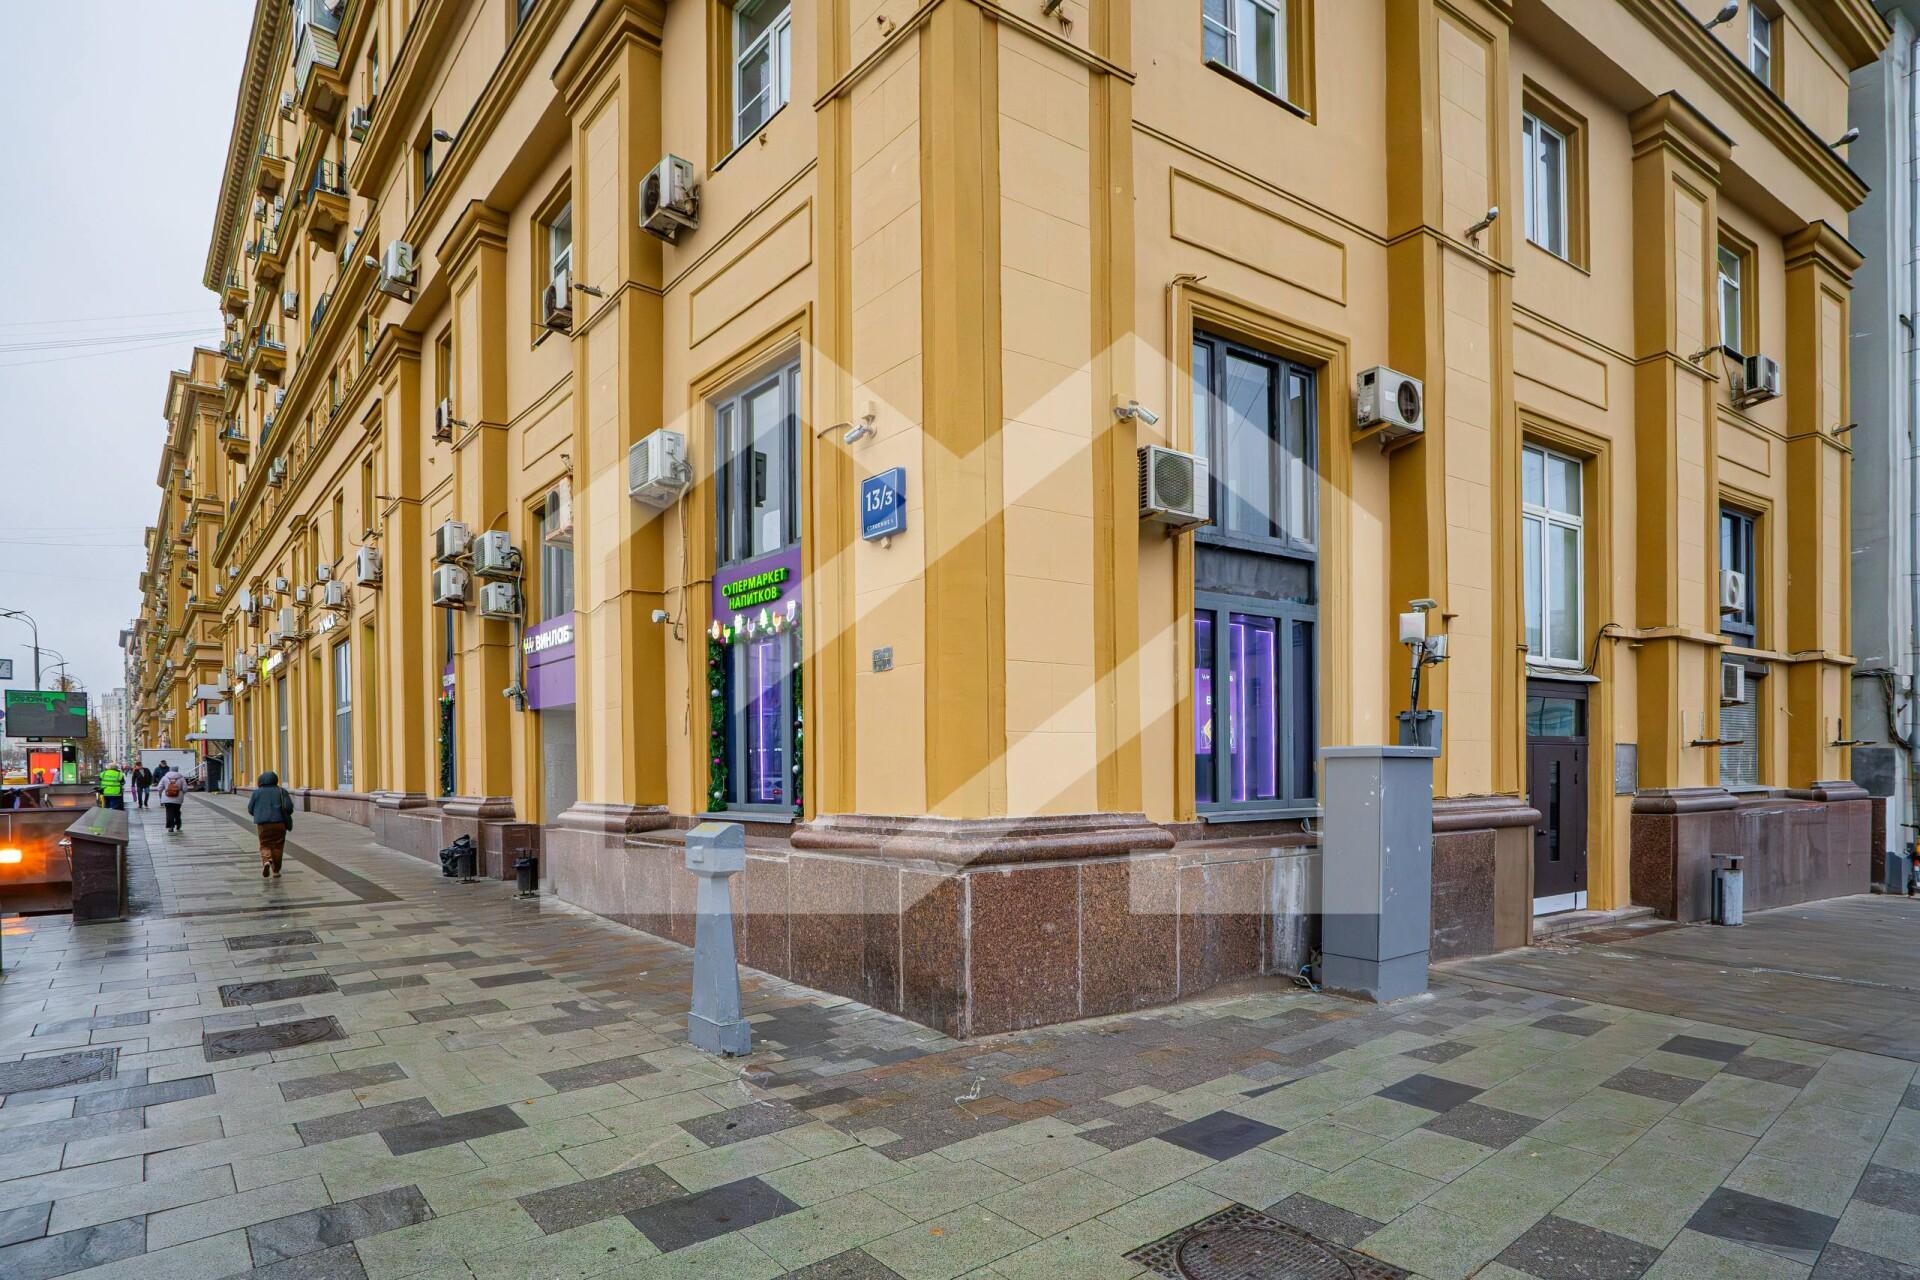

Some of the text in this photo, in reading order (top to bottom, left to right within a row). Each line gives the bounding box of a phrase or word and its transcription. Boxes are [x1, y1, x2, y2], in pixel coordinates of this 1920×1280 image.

[865, 485, 893, 512] 13/3
[721, 567, 785, 597] СУПЕРМАРКЕТ
[728, 586, 777, 610] НАПИТКОВ
